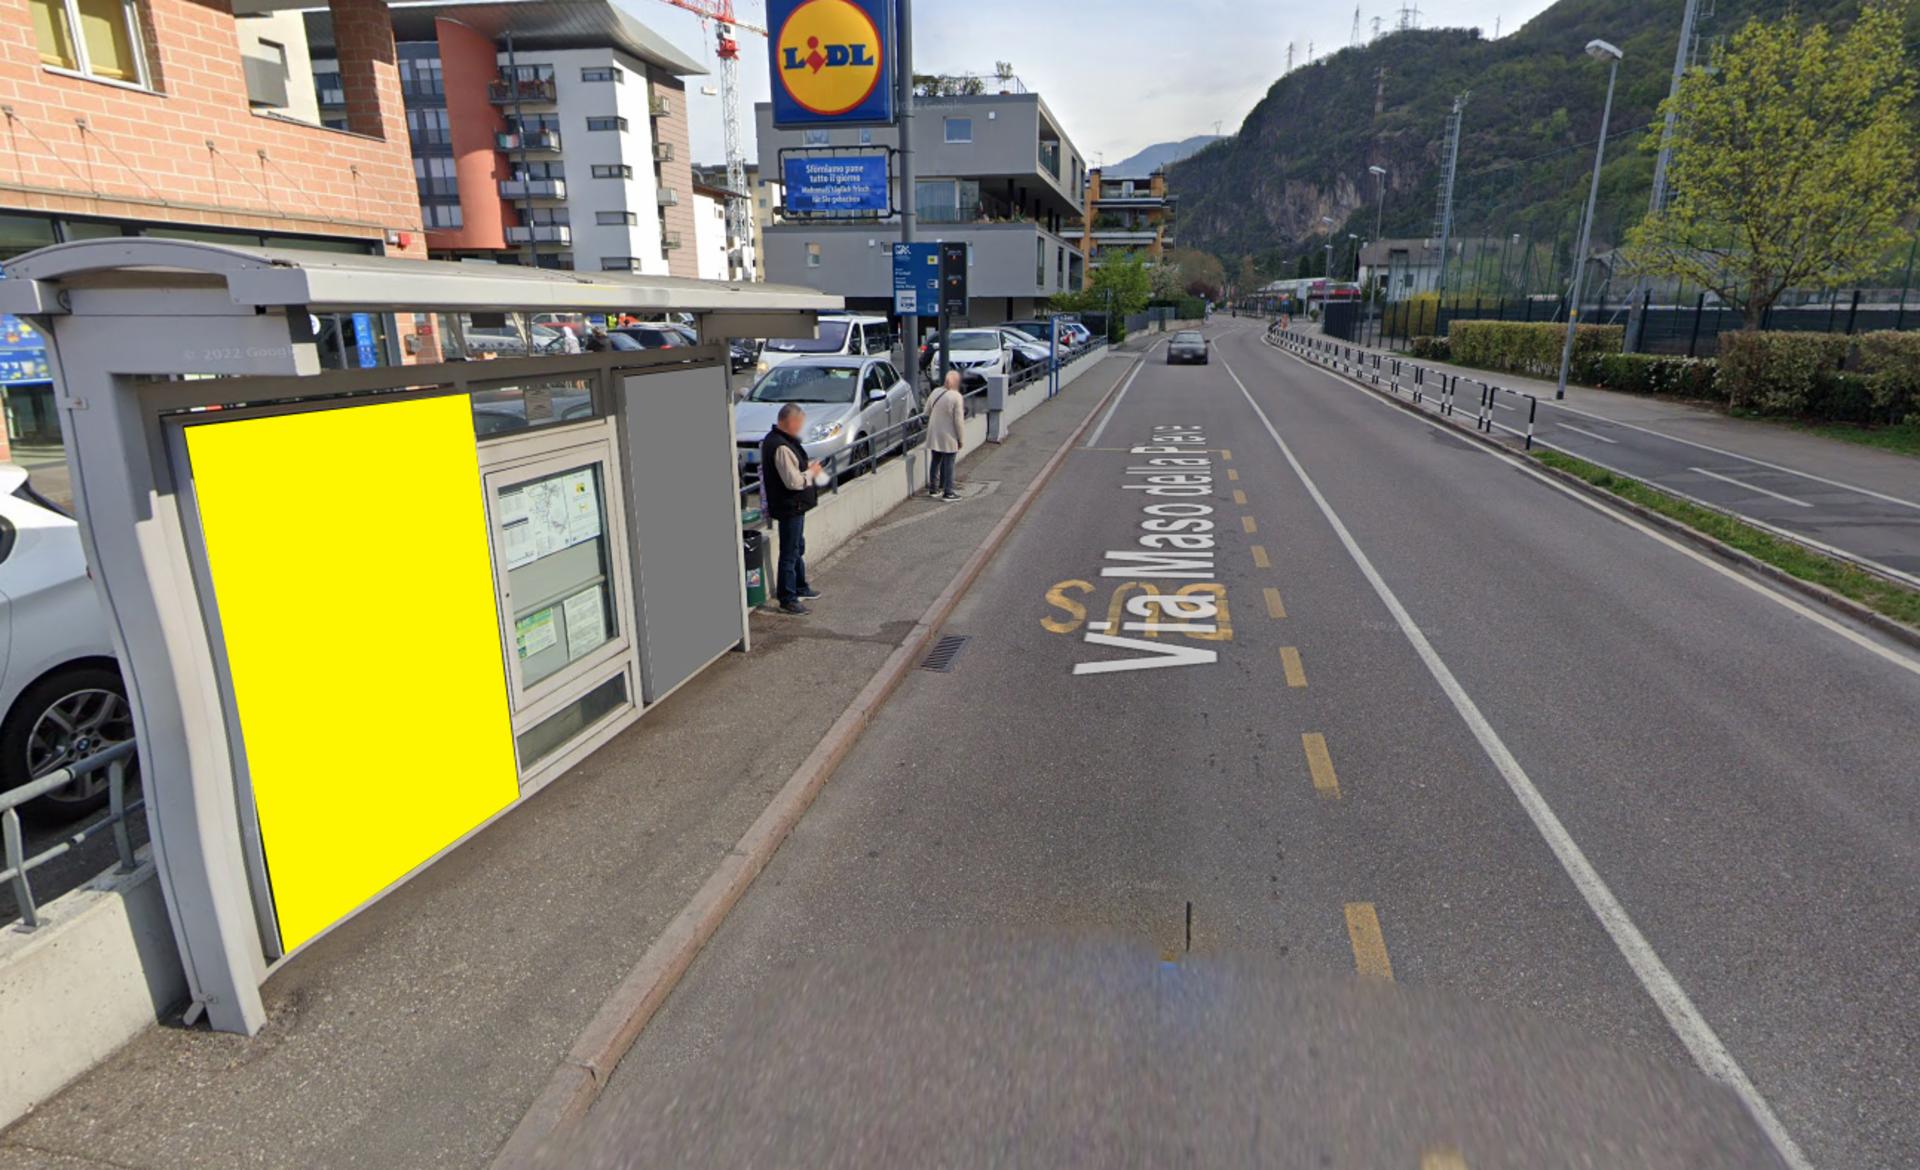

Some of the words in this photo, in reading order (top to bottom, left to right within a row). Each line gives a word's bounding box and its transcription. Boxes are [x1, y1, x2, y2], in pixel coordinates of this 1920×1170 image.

[845, 165, 864, 174] pane
[809, 174, 828, 183] tutto
[836, 173, 861, 184] giorno
